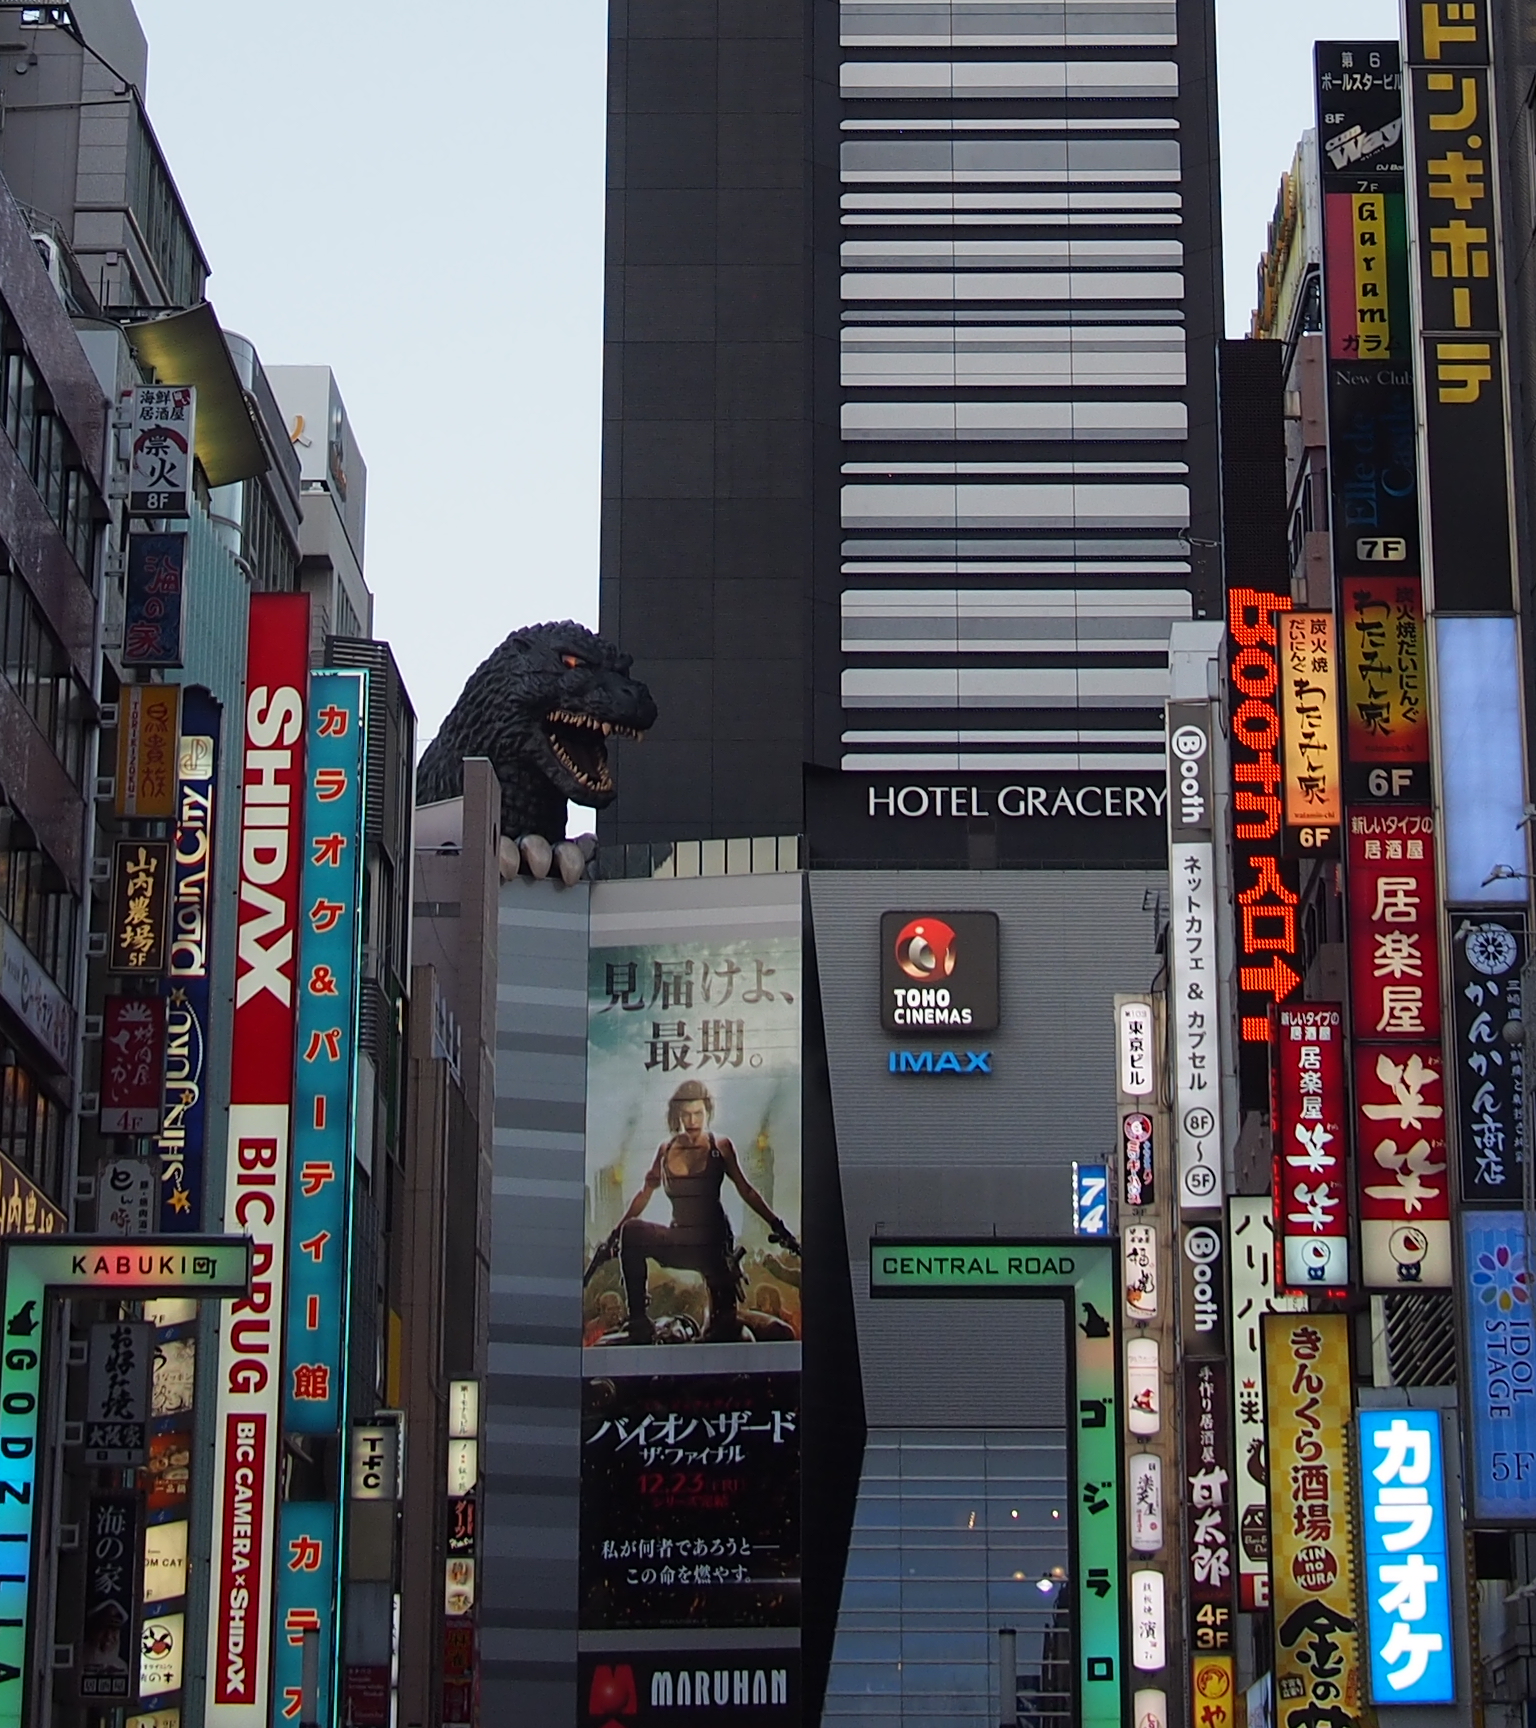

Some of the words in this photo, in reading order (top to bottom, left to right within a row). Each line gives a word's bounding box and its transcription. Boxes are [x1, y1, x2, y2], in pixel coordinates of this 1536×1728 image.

[1357, 181, 1379, 192] 7F
[1358, 202, 1387, 323] Garam
[1336, 370, 1372, 387] New
[139, 406, 185, 421] 居酒屋
[146, 495, 169, 509] 8F
[1362, 542, 1401, 558] 7F
[1289, 619, 1306, 673] だいにんぐ
[1311, 619, 1328, 673] 炭火焼
[1368, 769, 1413, 796] 6F
[868, 786, 988, 818] HOTEL
[998, 785, 1166, 819] GRACERY
[1299, 827, 1331, 848] 6F
[1352, 816, 1433, 835] 新しいタイプの
[1364, 840, 1424, 860] 居酒屋
[120, 846, 159, 954] 山内農場
[1183, 856, 1204, 971] ネットカフェ
[128, 952, 147, 966] 5F
[1372, 876, 1425, 1033] 居楽屋
[600, 960, 795, 1013] 見届けよ、
[893, 988, 950, 1007] TOHO
[894, 1008, 972, 1025] CINEMAS
[1281, 1011, 1339, 1025] 新しいタイプの
[1290, 1027, 1330, 1041] 居酒屋
[644, 1017, 763, 1072] 最期。
[888, 1051, 991, 1073] IMAX
[1129, 1021, 1145, 1085] 東京ビル
[1188, 1010, 1207, 1092] カプセル
[1299, 1046, 1322, 1119] 居楽屋
[1465, 980, 1505, 1186] かんかん商店
[117, 1110, 143, 1132] 4F
[235, 1137, 277, 1227] BIC
[882, 1258, 999, 1275] CENTRAL
[1008, 1257, 1076, 1275] ROAD
[1184, 1226, 1220, 1332] Booth
[1485, 1320, 1511, 1419] STAGE
[1510, 1321, 1532, 1402] IDOL
[585, 1409, 796, 1451] バイオハザード
[1198, 1365, 1215, 1464] 手作り居酒屋
[237, 1422, 255, 1458] BIC
[1290, 1326, 1332, 1542] きんくら酒場
[362, 1437, 384, 1489] TFC
[1491, 1452, 1535, 1482] 5F
[638, 1473, 706, 1494] 12.23
[232, 1460, 255, 1573] CAMERA
[1189, 1466, 1230, 1587] 甘太郎
[94, 1505, 127, 1594] 海の家
[1298, 1547, 1326, 1562] KIN
[1305, 1562, 1324, 1572] no
[1372, 1419, 1442, 1691] カラオケ
[625, 1565, 753, 1586] この命を燃やす。
[1297, 1574, 1335, 1587] KURA
[1196, 1605, 1228, 1625] 4F
[1197, 1629, 1228, 1649] 3F
[650, 1669, 788, 1707] MARUHAN
